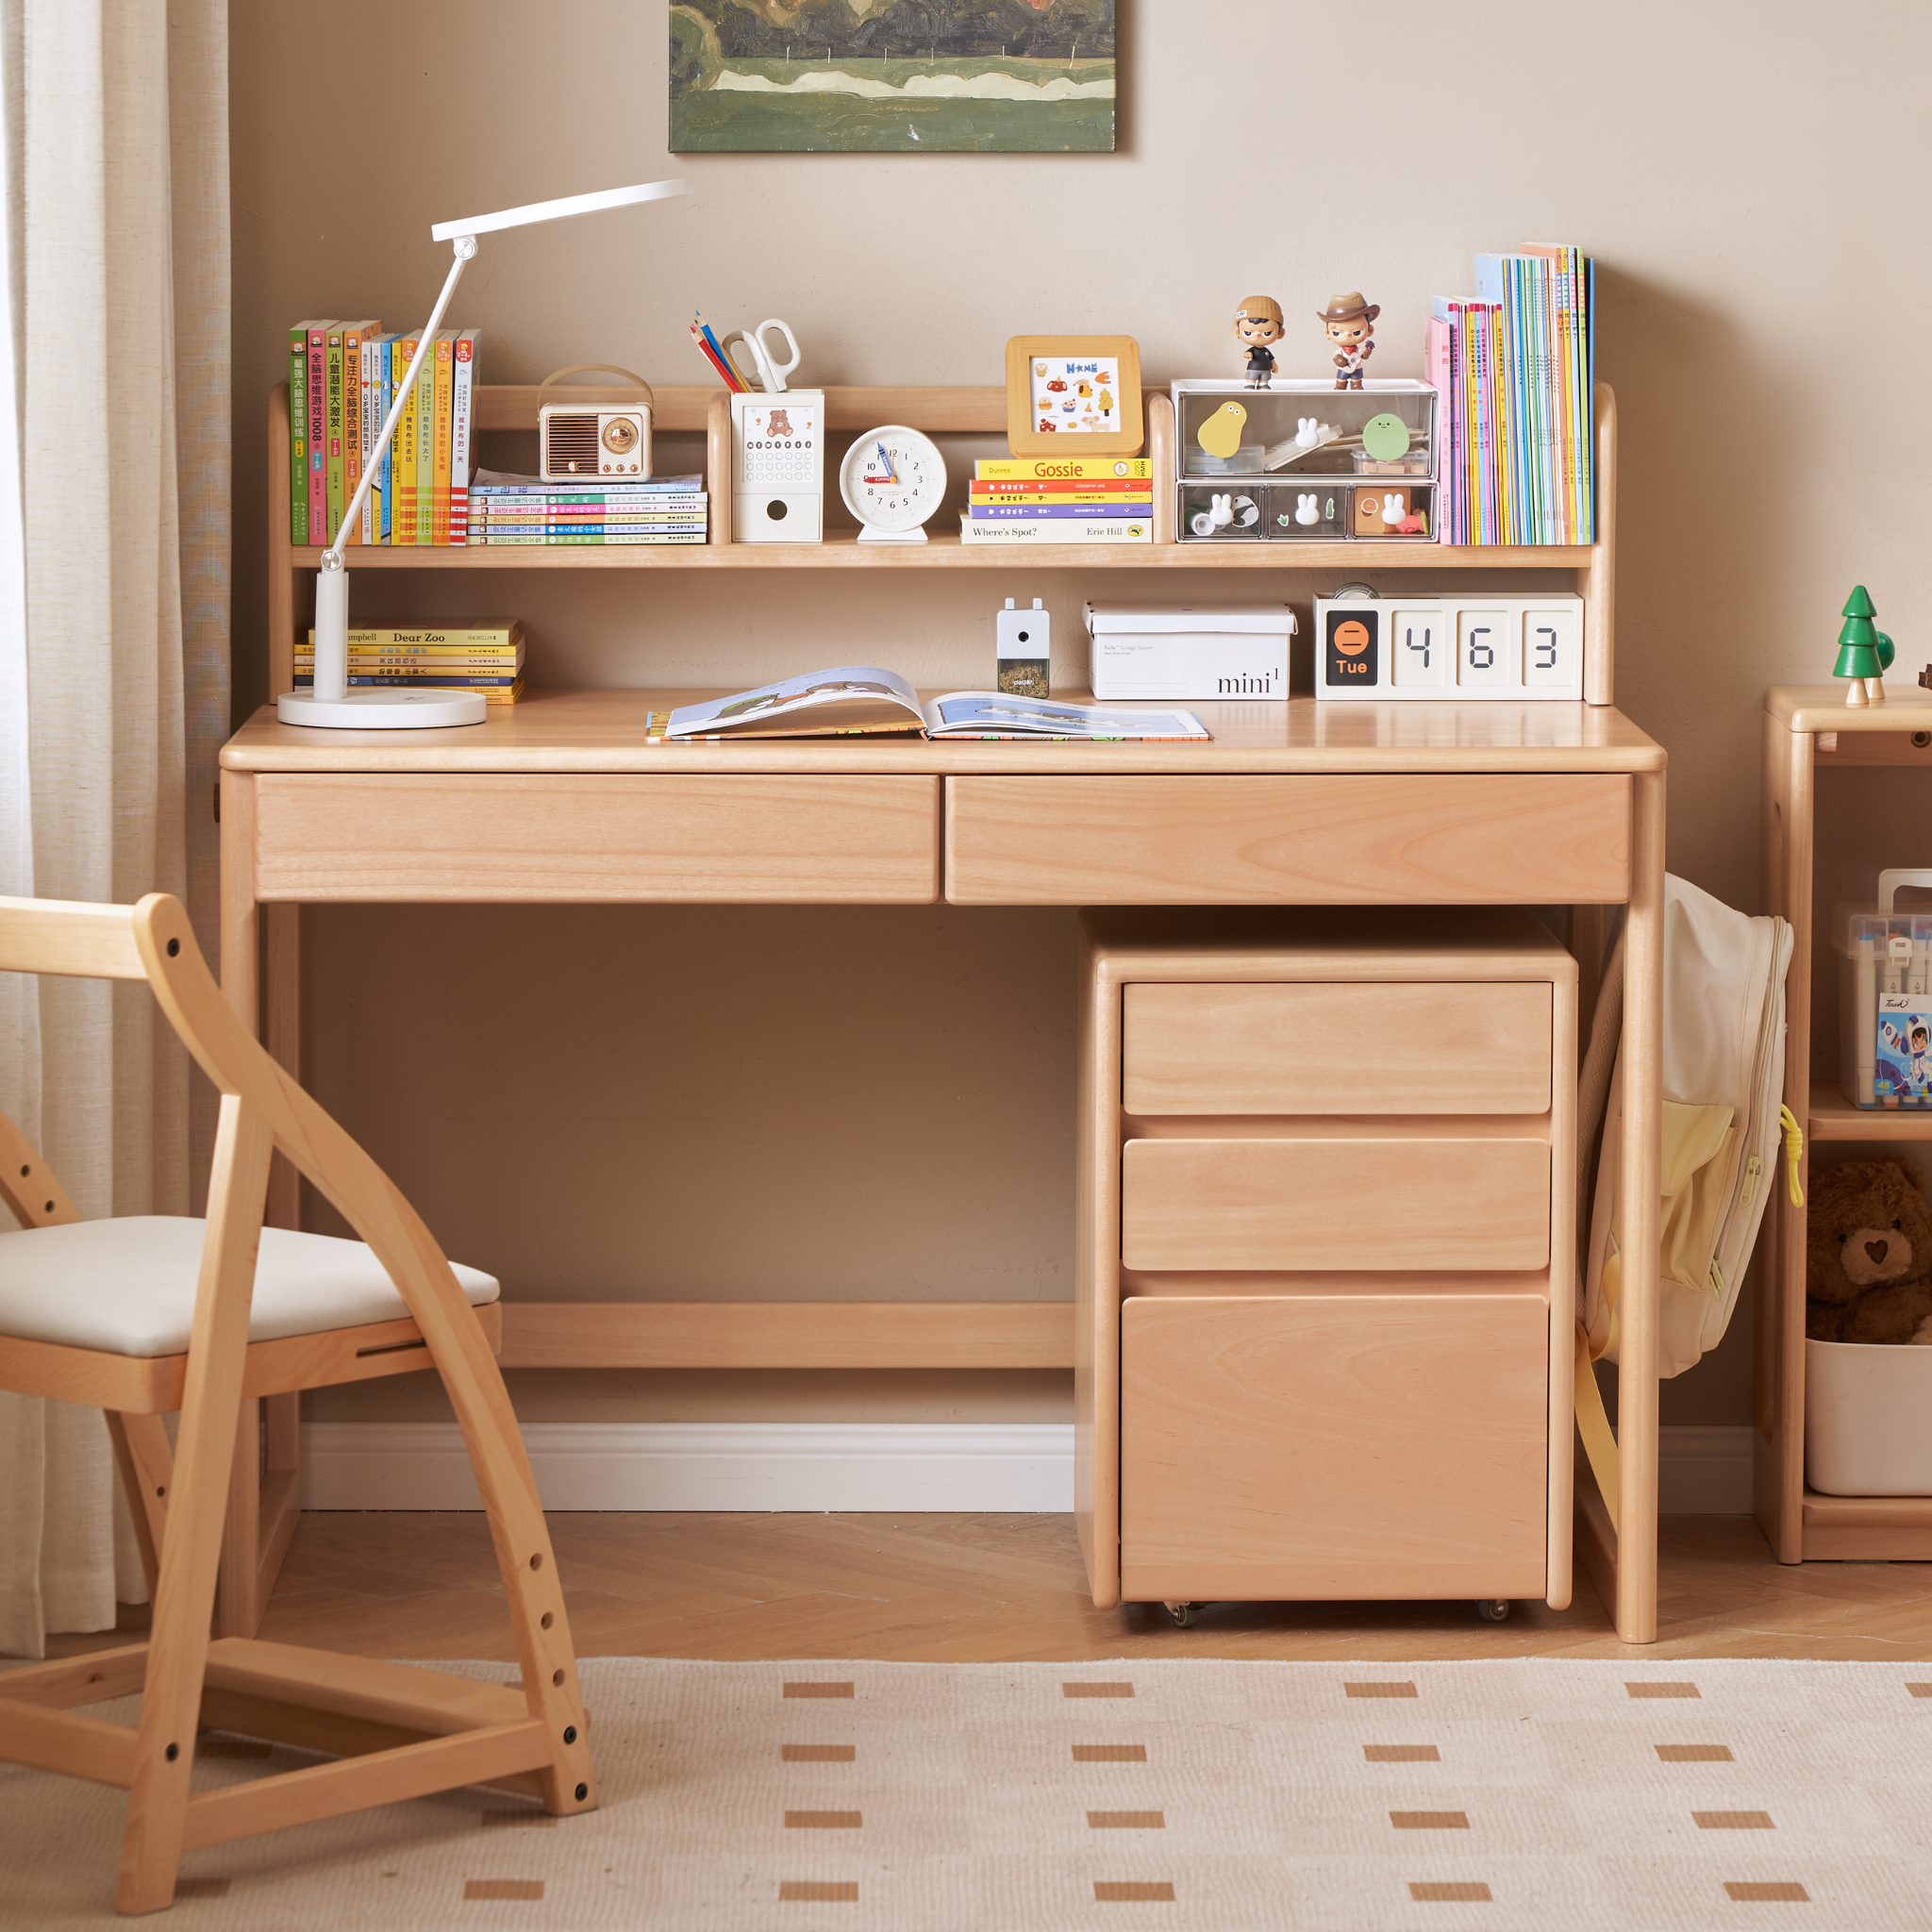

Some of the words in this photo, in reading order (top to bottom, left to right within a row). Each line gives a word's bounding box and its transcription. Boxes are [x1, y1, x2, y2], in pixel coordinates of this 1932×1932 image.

[330, 353, 340, 427] 儿童潜能大激发
[293, 359, 304, 437] 最强大脑思维训练
[347, 355, 358, 449] 专注力全脑综合测试
[913, 462, 919, 470] 2
[1034, 462, 1083, 477] Gossie
[973, 528, 1009, 536] Where's
[1012, 528, 1037, 538] Spot?
[348, 633, 376, 642] ampbell
[393, 633, 421, 642] Dear
[425, 633, 445, 642] Zoo
[1406, 628, 1431, 669] 4
[1469, 628, 1494, 669] 6
[1535, 628, 1556, 669] 3
[1336, 660, 1367, 674] Tue
[1218, 672, 1271, 693] mini
[1878, 1081, 1890, 1089] 48
